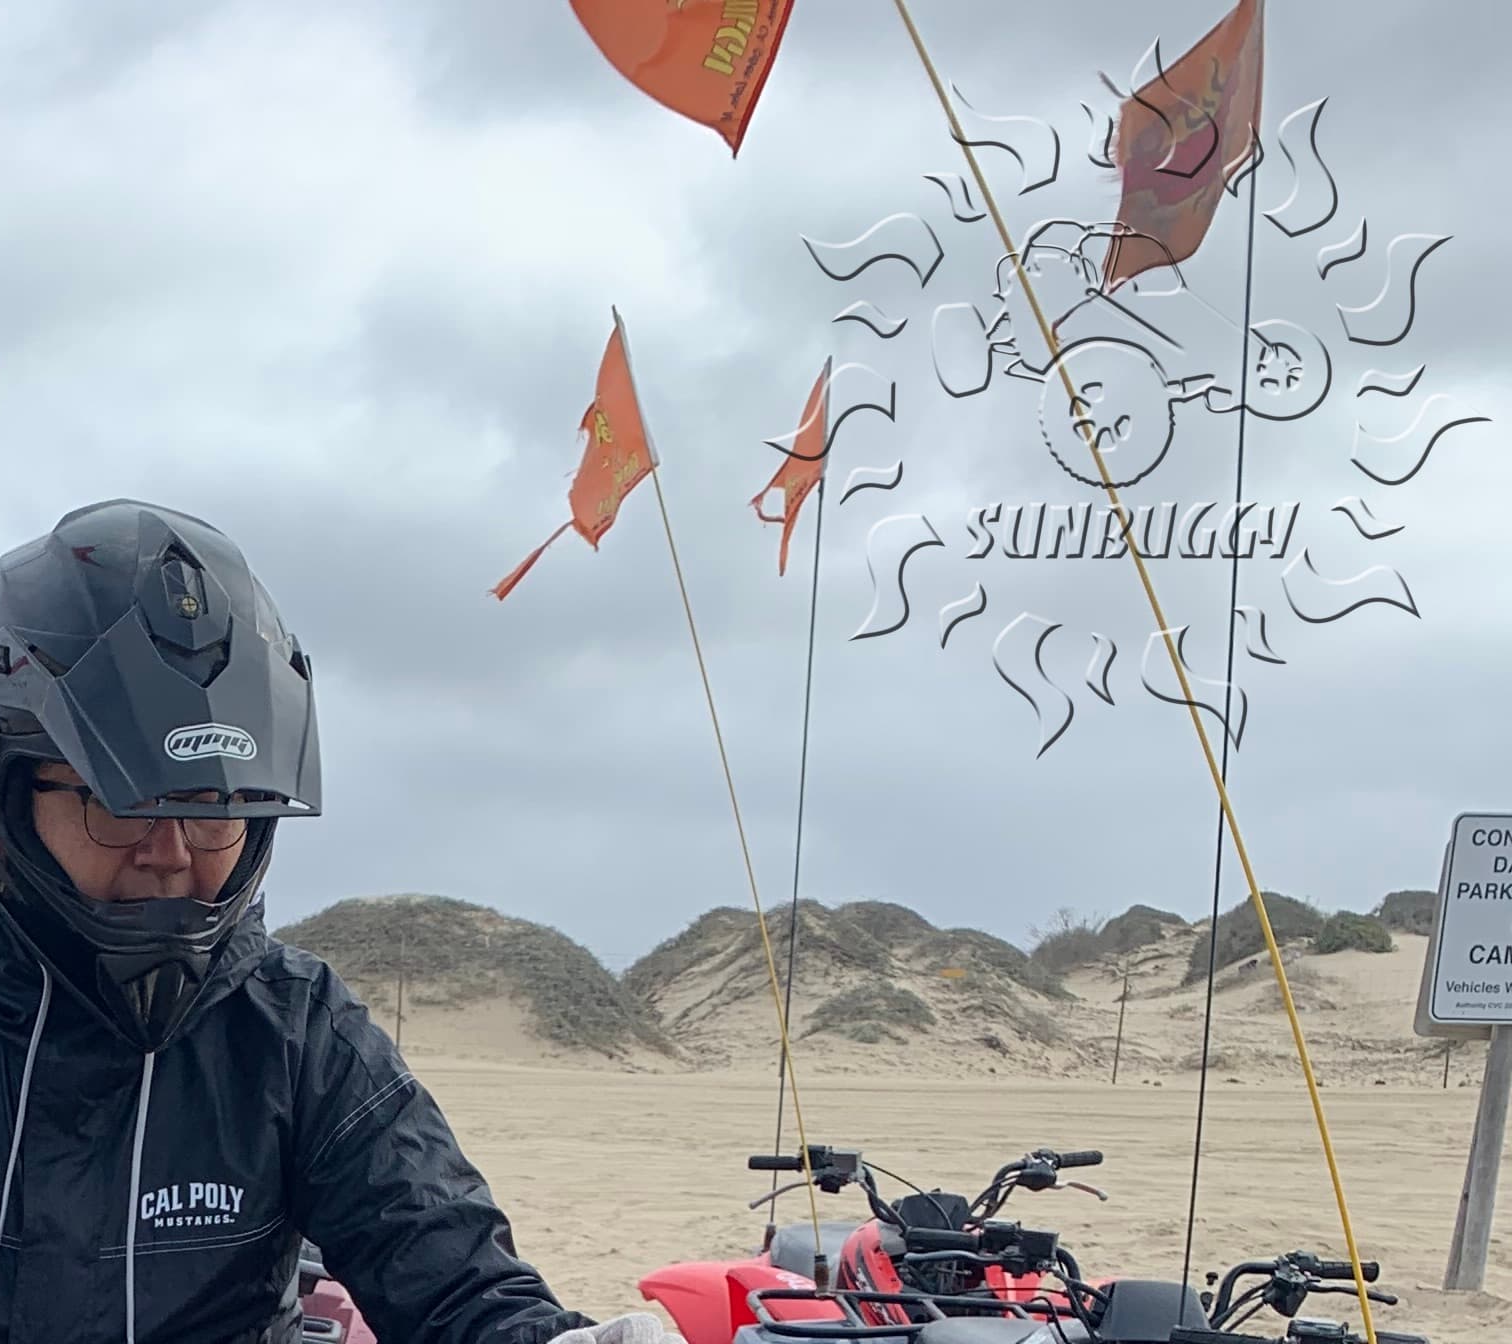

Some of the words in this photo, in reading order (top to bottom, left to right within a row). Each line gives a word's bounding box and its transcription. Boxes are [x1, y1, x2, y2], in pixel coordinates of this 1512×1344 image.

[1457, 882, 1512, 900] PARK
[1446, 980, 1500, 994] Vehicles
[141, 1184, 183, 1220] CAL
[188, 1182, 244, 1213] POLY
[154, 1214, 230, 1228] MUSTANGS
